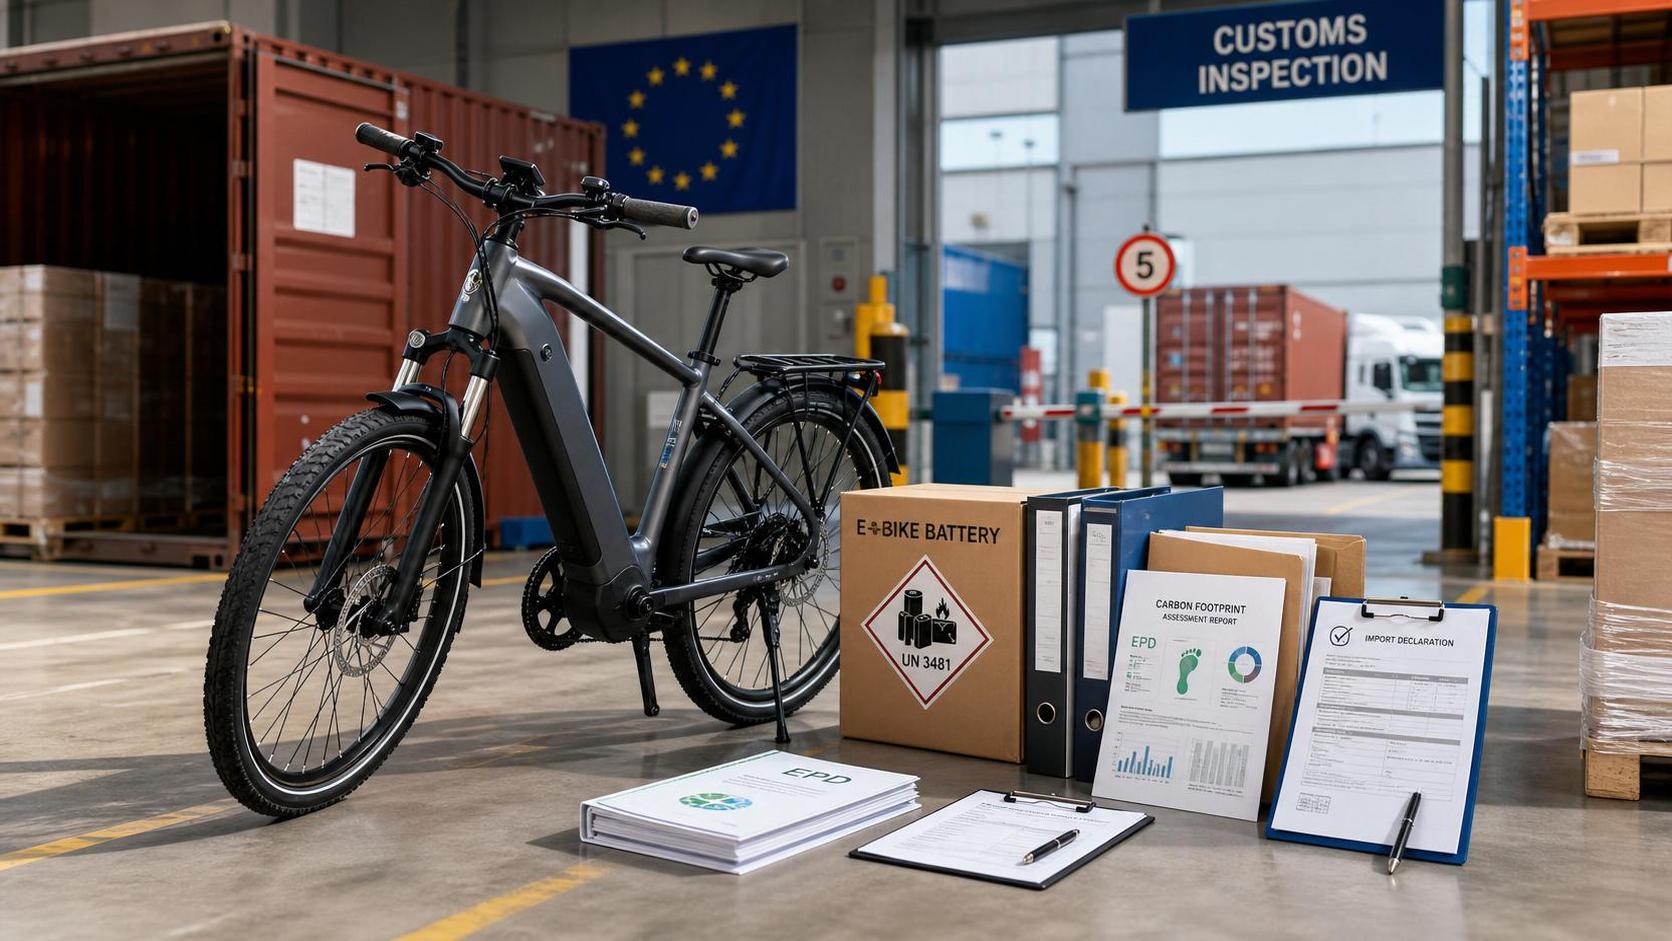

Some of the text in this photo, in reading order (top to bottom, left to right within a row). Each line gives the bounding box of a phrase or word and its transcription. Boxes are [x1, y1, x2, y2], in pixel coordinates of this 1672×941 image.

[1213, 14, 1367, 55] CUSTOMS
[1198, 52, 1387, 94] INSPECTION
[1136, 251, 1154, 280] 5
[925, 523, 1001, 545] BATTERY
[1155, 600, 1246, 614] CARBON FOOTPRINT
[1162, 613, 1238, 626] ASSESSMENT REPORT
[1131, 635, 1157, 649] EPD
[1365, 635, 1454, 646] IMPORT DECLARATION
[901, 653, 951, 671] UN 3481
[782, 767, 853, 785] EPD
